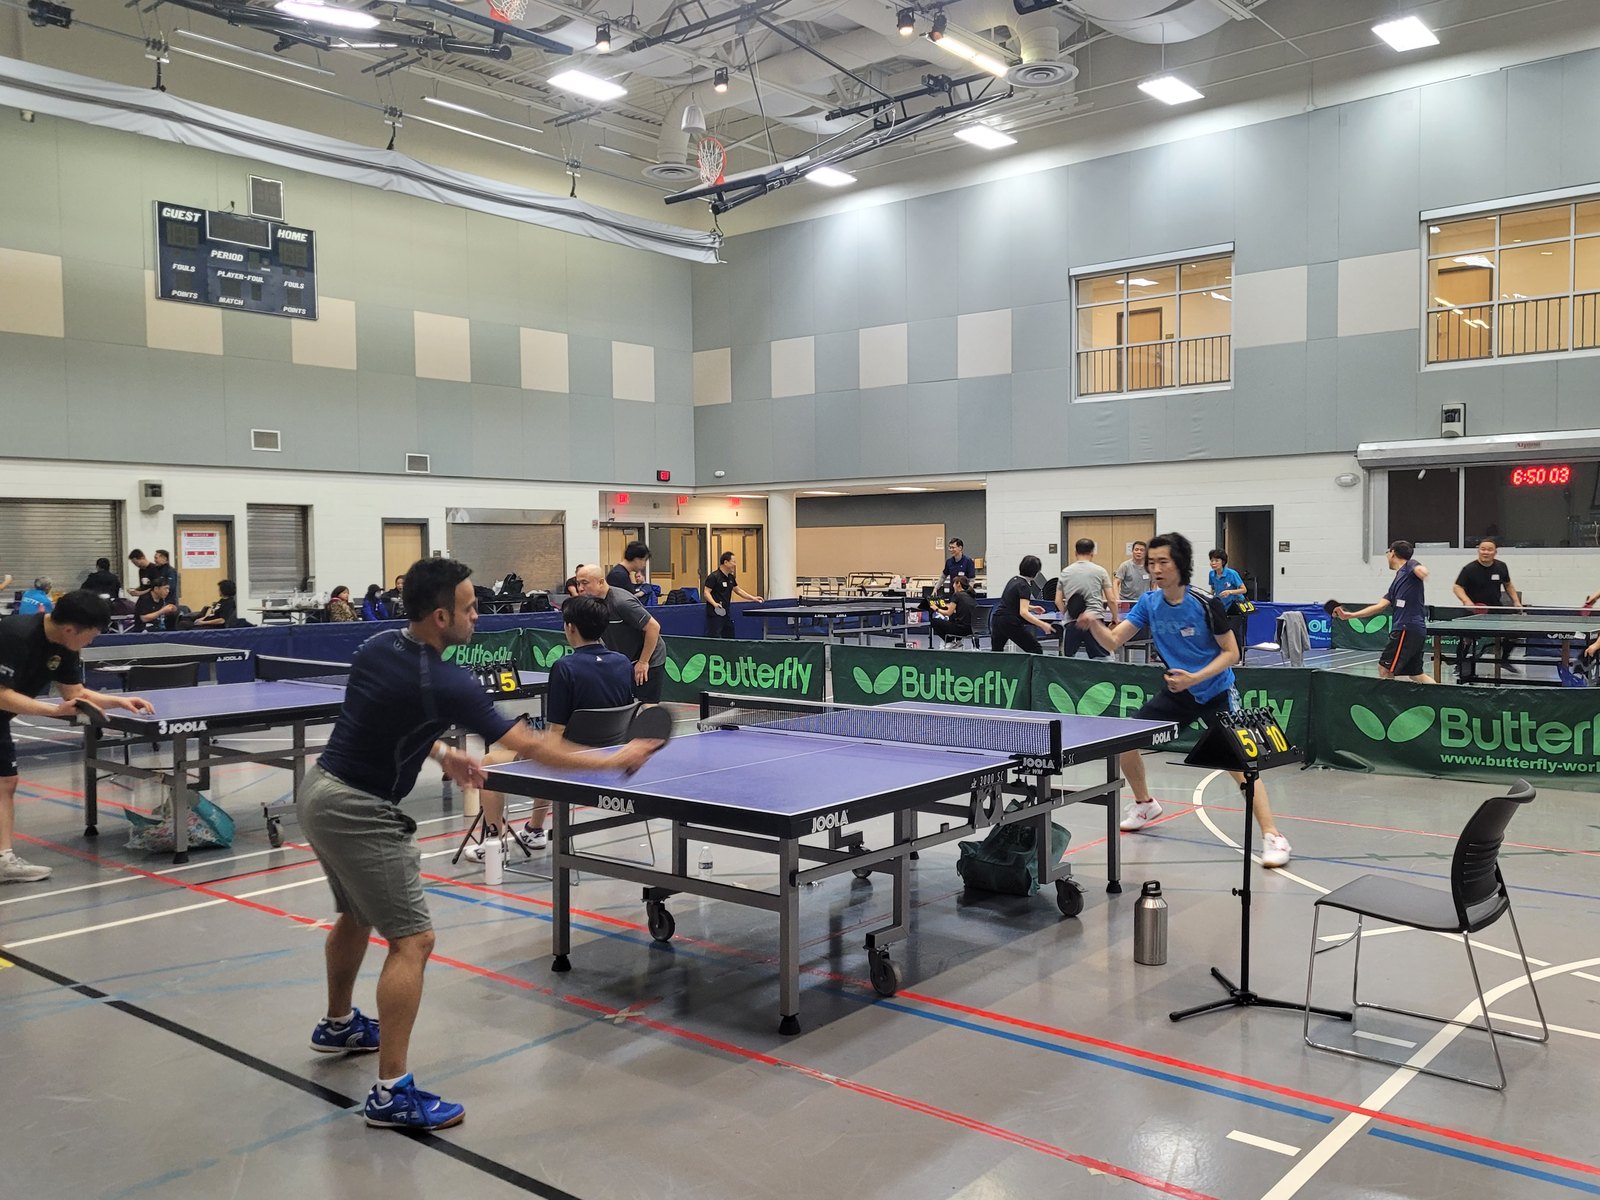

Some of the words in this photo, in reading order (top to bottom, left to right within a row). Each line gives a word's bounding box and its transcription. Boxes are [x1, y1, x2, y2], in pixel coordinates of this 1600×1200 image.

[162, 207, 201, 222] GUEST
[277, 229, 308, 242] HOME
[211, 250, 244, 262] PERIOD
[172, 263, 196, 273] FOULS
[217, 270, 264, 283] PLAYER-FOUL
[284, 280, 305, 289] FOULS
[171, 289, 198, 299] POINTS
[219, 297, 244, 306] MATCH
[283, 306, 306, 315] POINTS
[1513, 468, 1546, 485] 6:50
[1549, 467, 1569, 483] 03
[709, 655, 812, 694] Butterfly
[500, 672, 516, 692] 5
[901, 666, 1018, 709] Butterfly
[158, 720, 168, 734] 3
[168, 720, 208, 734] JOOLA
[1152, 731, 1171, 745] JOOLA
[1173, 724, 1179, 739] 2
[1237, 729, 1258, 758] 5
[1266, 725, 1288, 753] 10
[1022, 757, 1055, 769] JOOLA
[598, 795, 635, 814] JOOLA
[811, 810, 849, 834] JOOLA
